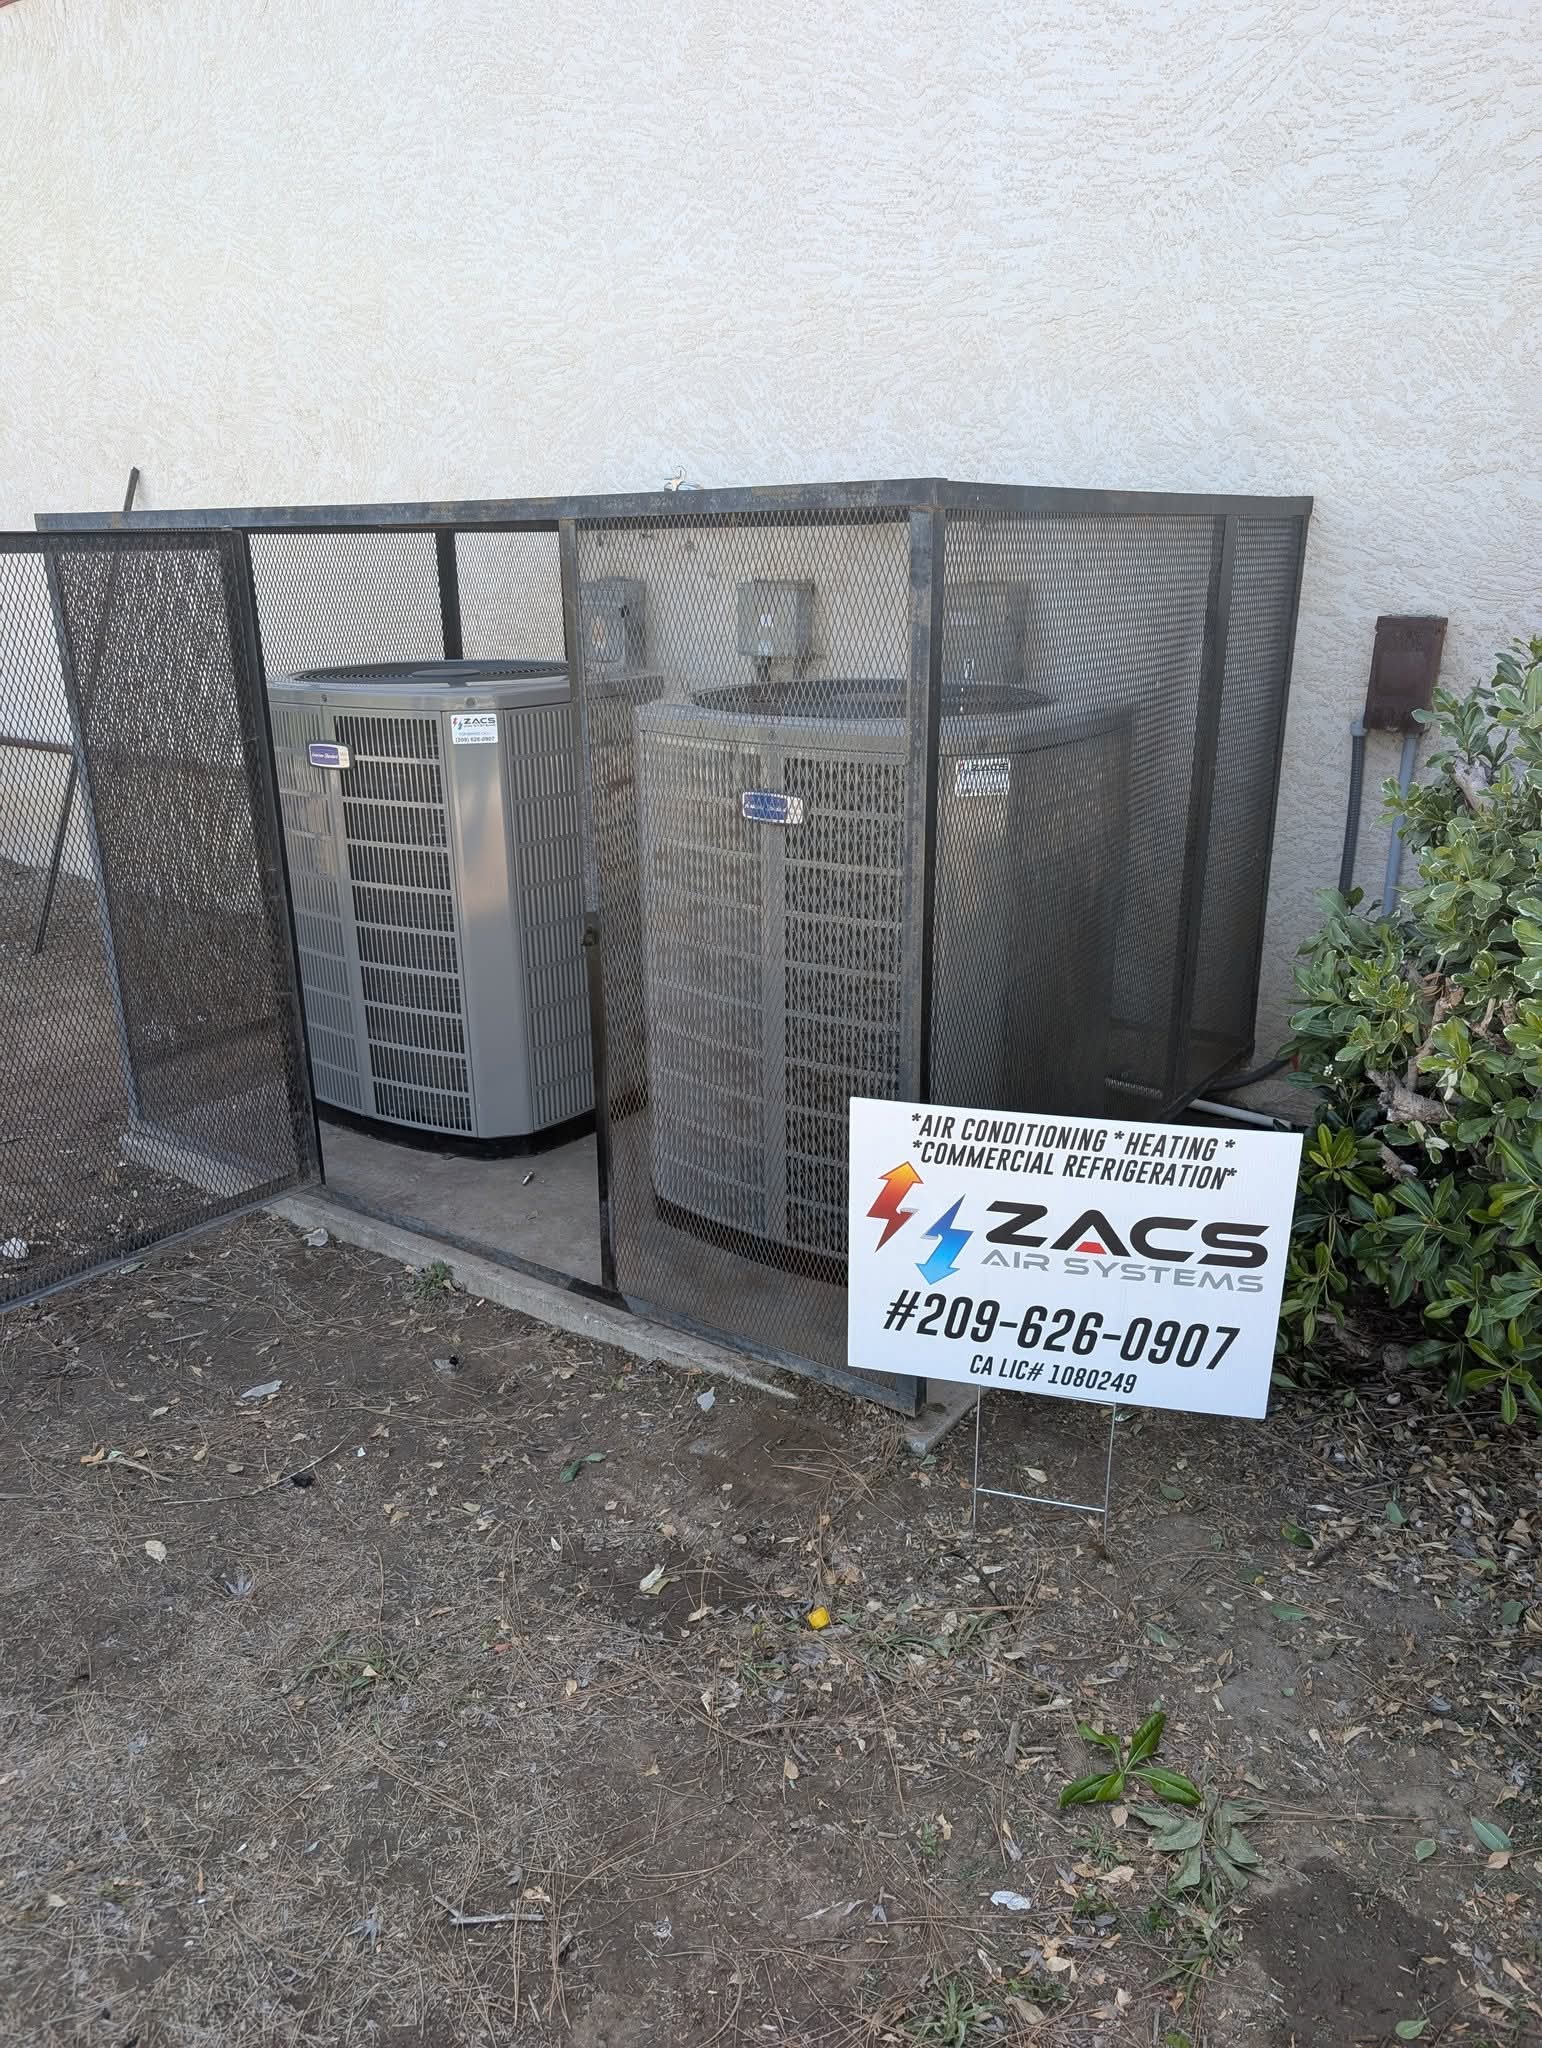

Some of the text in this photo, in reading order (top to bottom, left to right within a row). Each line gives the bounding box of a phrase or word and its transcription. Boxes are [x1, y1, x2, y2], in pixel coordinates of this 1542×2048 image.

[464, 717, 496, 725] ZACS
[960, 1117, 1108, 1152] CONDITIONING
[985, 1200, 1270, 1269] ZACS
[981, 1248, 1265, 1293] AIR SYSTEMS
[883, 1288, 1240, 1371] #209-626-0907
[970, 1354, 1138, 1394] CA LIC# 1080249
